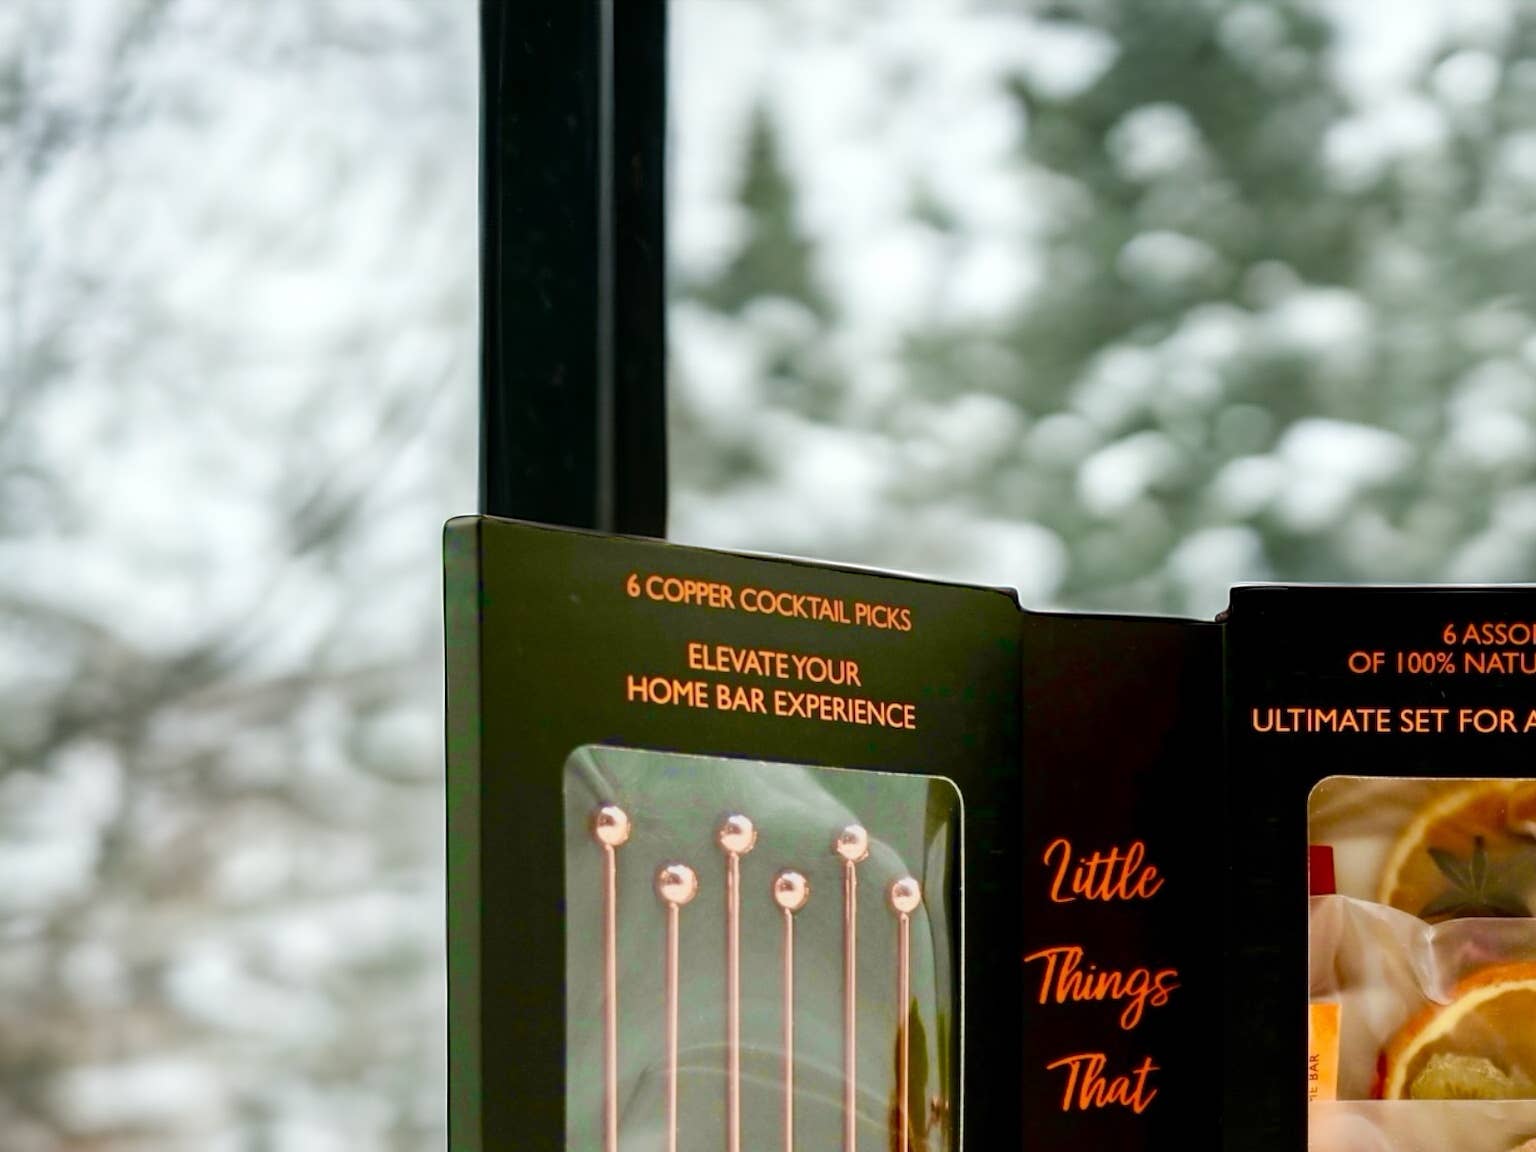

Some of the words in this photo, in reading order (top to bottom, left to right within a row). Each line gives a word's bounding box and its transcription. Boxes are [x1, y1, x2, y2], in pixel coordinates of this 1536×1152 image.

[627, 574, 640, 597] 6
[645, 575, 735, 609] COPPER
[740, 588, 851, 624] COCKTAIL
[855, 602, 911, 631] PICKS
[1443, 624, 1456, 645] 6
[688, 642, 789, 678] ELEVATE
[791, 655, 861, 687] YOUR
[1348, 651, 1385, 673] OF
[1398, 652, 1455, 673] 100%
[627, 675, 709, 708] HOME
[716, 684, 767, 714] BAR
[774, 690, 916, 729] EXPERIENCE
[1253, 708, 1391, 732] ULTIMATE
[1400, 709, 1449, 733] SET
[1460, 709, 1518, 733] FOR
[1043, 838, 1164, 903] Little
[1024, 945, 1181, 1030] Things
[1046, 1052, 1159, 1114] That
[1309, 1054, 1319, 1081] BAR
